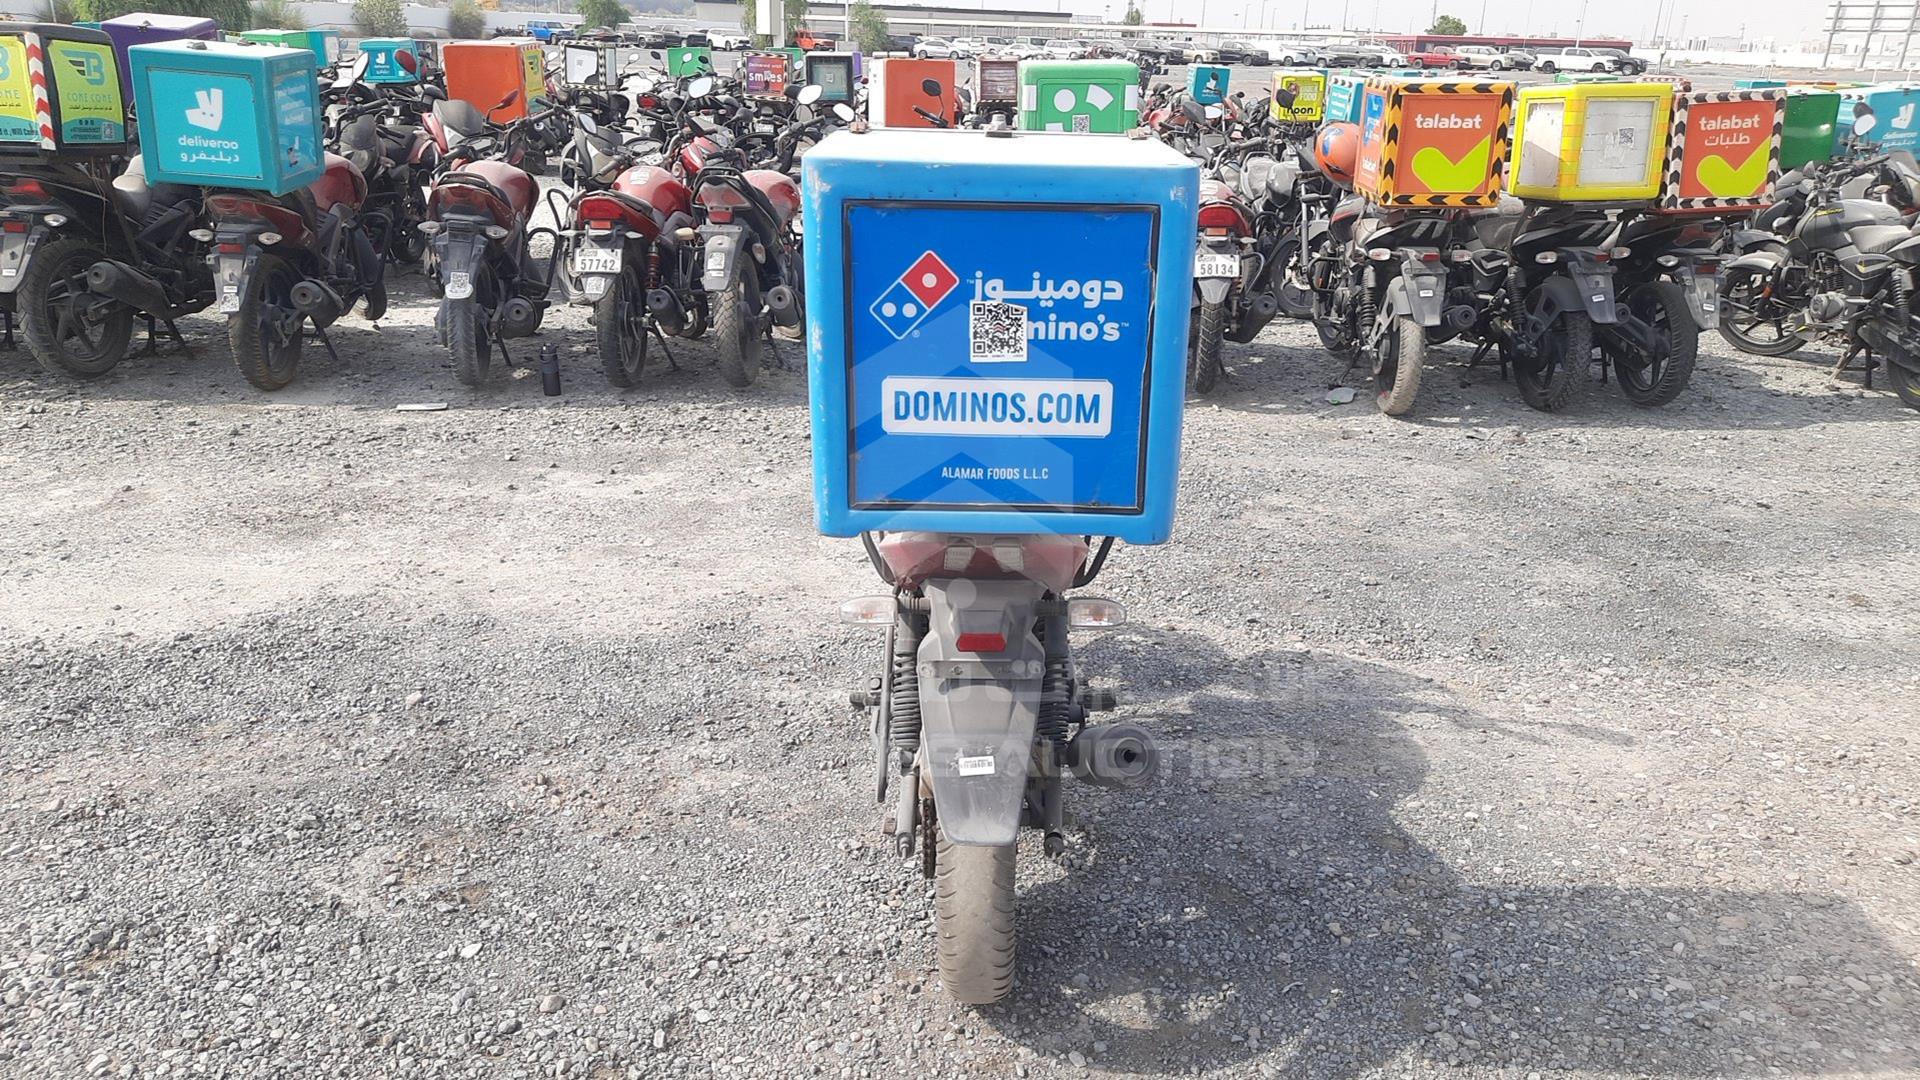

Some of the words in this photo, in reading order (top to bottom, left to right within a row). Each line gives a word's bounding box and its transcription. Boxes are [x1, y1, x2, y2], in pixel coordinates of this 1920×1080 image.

[1415, 113, 1483, 129] talabat
[1698, 114, 1761, 131] talabat
[178, 134, 239, 150] deliveroo
[1704, 132, 1750, 149] طلبات
[580, 258, 616, 271] 57742
[1200, 263, 1234, 275] 58134
[1027, 313, 1121, 342] mino's
[893, 390, 1101, 424] DOMINOS.COM
[941, 466, 984, 480] ALAMAR
[987, 467, 1021, 481] FOODS
